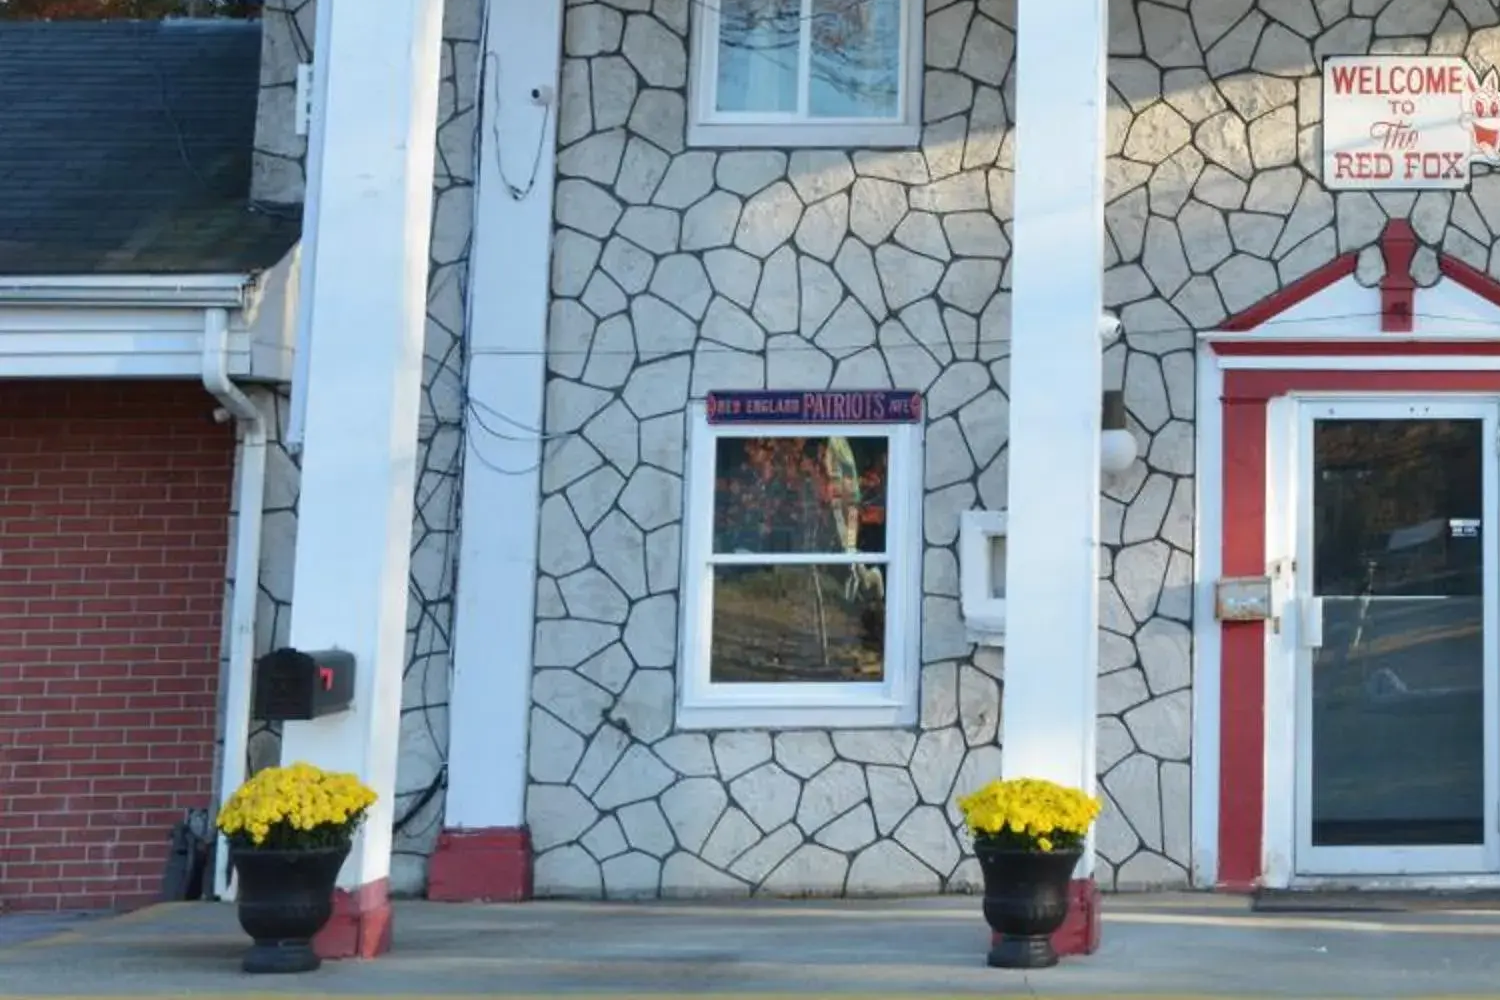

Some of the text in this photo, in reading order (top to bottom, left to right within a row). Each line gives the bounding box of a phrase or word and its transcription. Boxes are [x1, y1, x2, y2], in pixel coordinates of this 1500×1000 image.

[1332, 66, 1462, 95] WELCOME
[1388, 99, 1415, 115] TO
[1370, 120, 1419, 149] The
[1334, 152, 1465, 179] RED FOX
[803, 392, 886, 419] PATRIOTS
